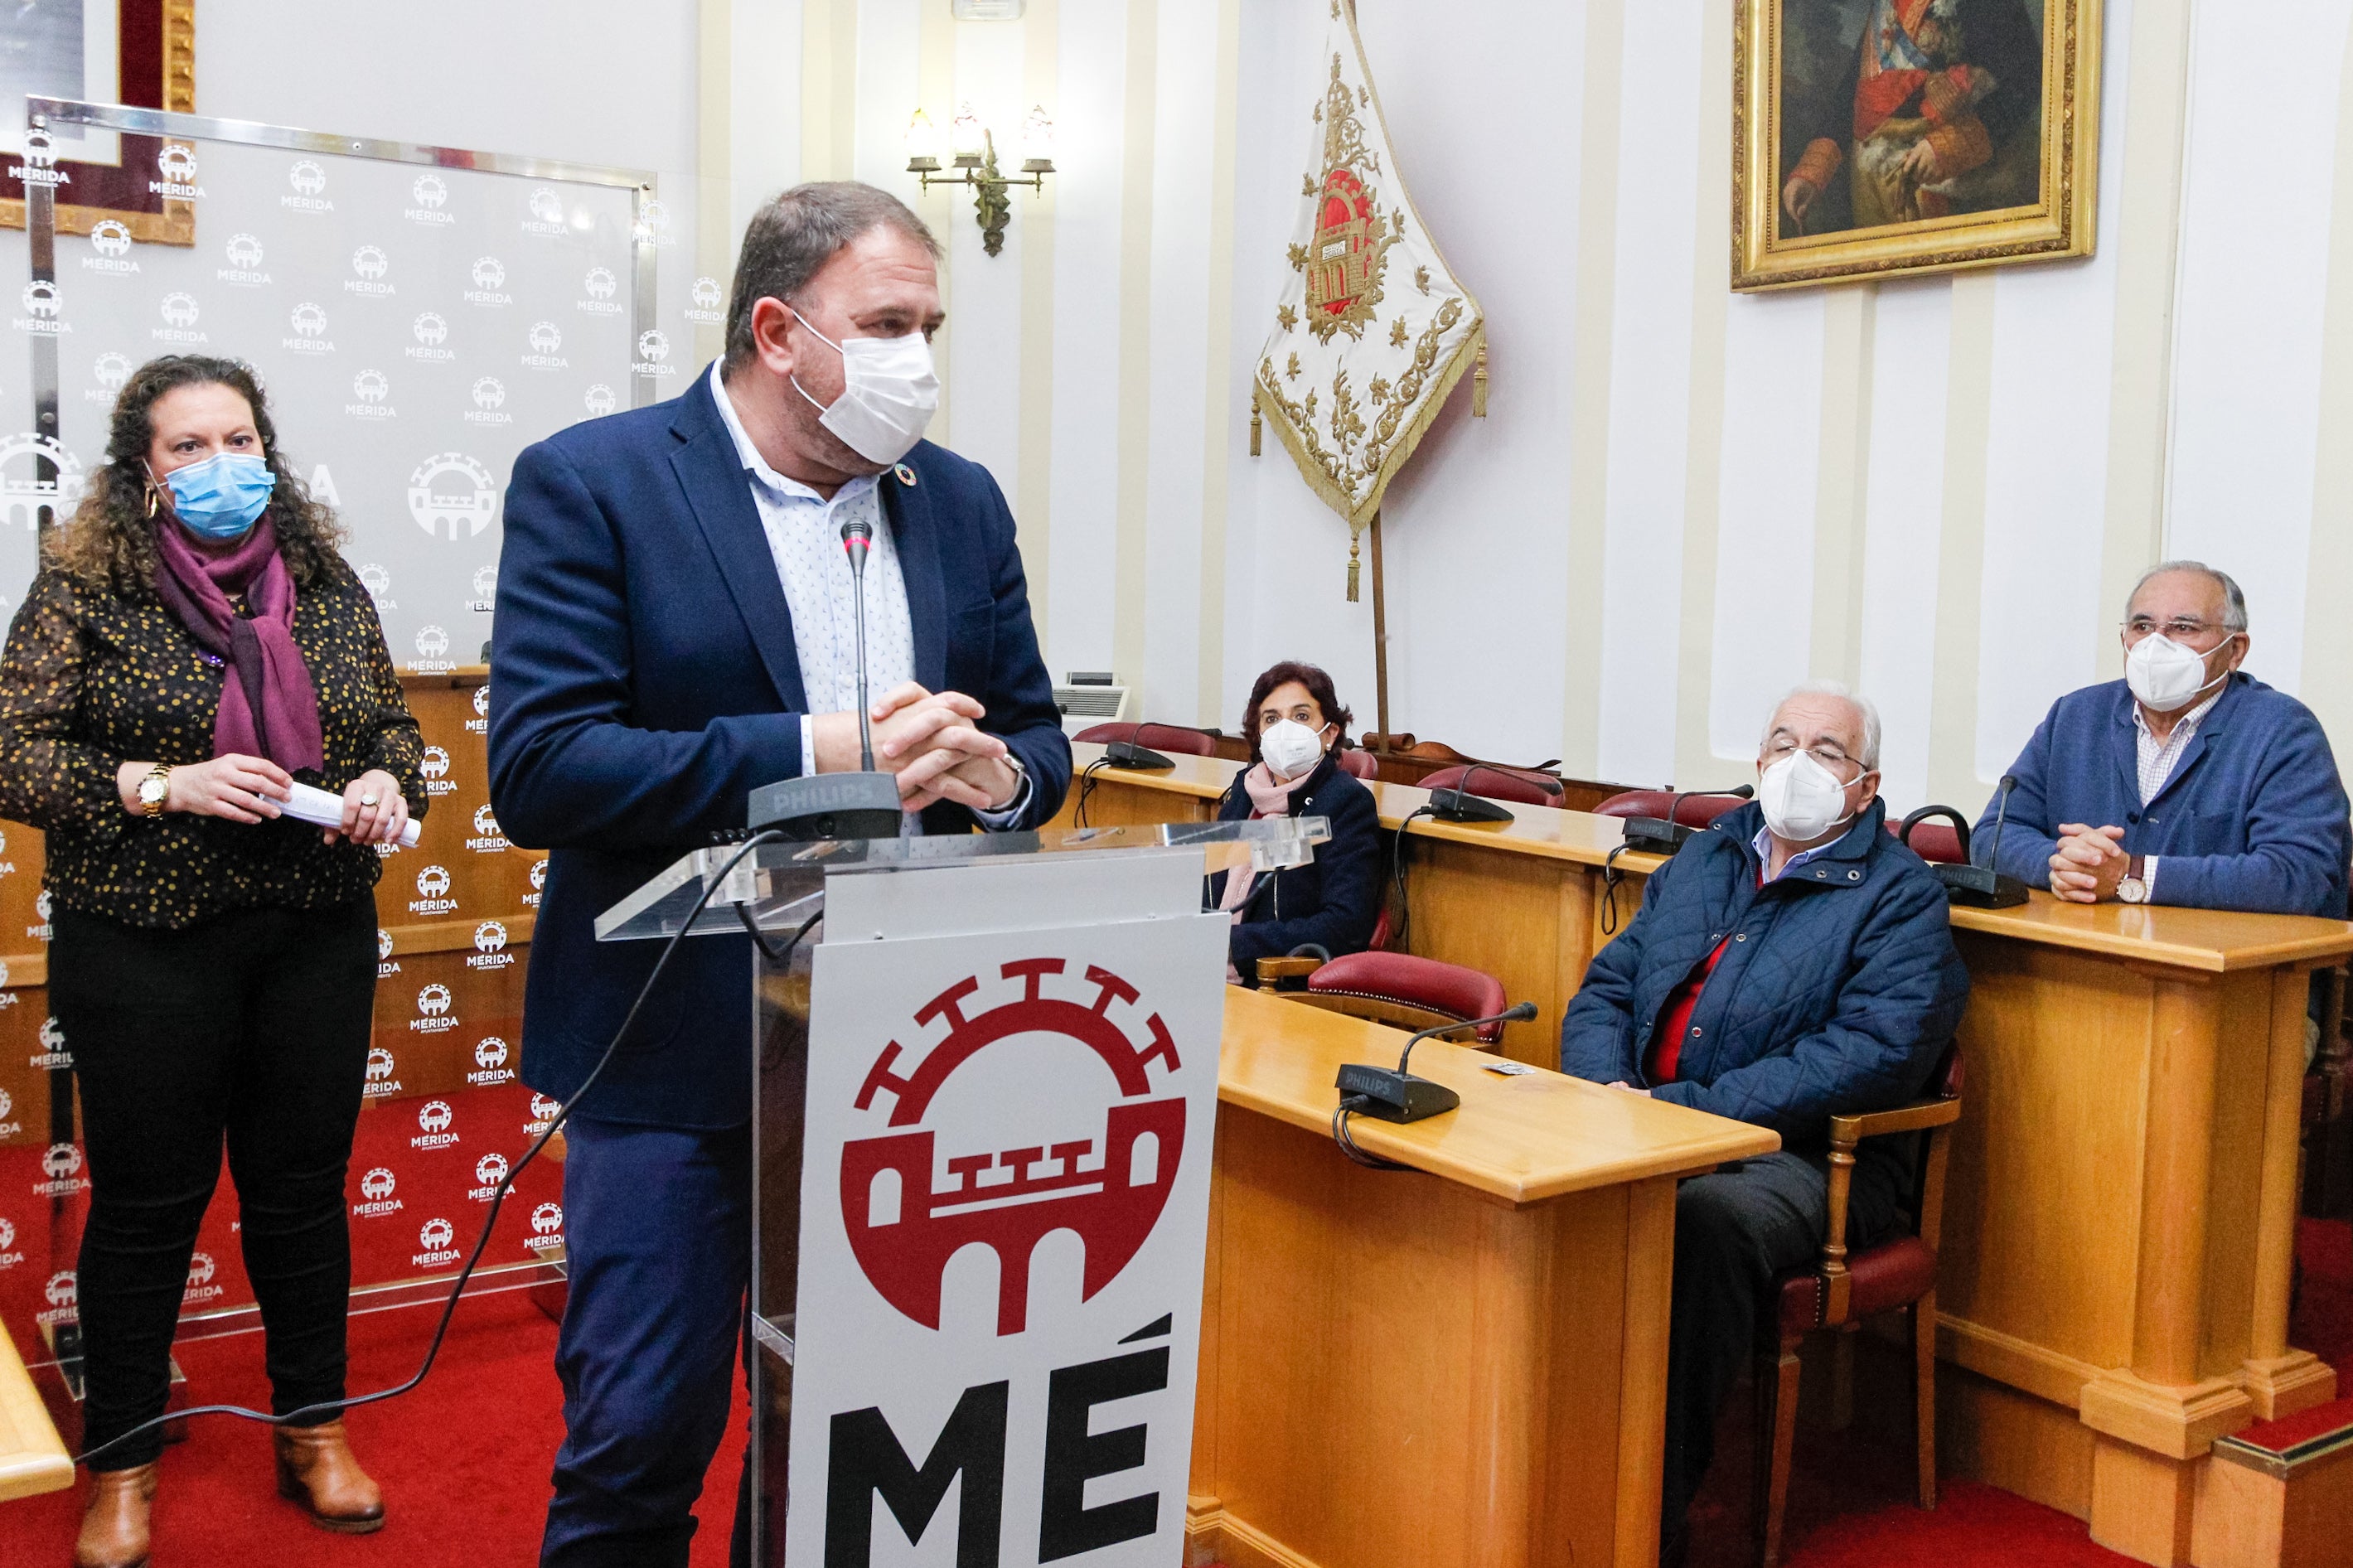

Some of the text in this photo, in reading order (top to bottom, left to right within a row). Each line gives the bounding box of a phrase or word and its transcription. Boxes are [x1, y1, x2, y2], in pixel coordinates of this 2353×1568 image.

[8, 166, 70, 183] MÉRIDA
[149, 180, 206, 198] MÉRIDA
[281, 195, 334, 212] MÉRIDA
[405, 208, 455, 225] MÉRIDA
[522, 220, 569, 236] MÉRIDA
[83, 256, 140, 273] MÉRIDA
[217, 268, 272, 285] MÉRIDA
[345, 279, 395, 295] MÉRIDA
[464, 289, 512, 305] MÉRIDA
[578, 299, 623, 314] MÉRIDA
[12, 317, 73, 333] MÉRIDA
[153, 327, 208, 344] MÉRIDA
[283, 336, 336, 352] MÉRIDA
[405, 345, 455, 360] MÉRIDA
[521, 353, 568, 368] MÉRIDA
[632, 361, 675, 375] MÉRIDA
[85, 389, 116, 401] MÉR
[346, 403, 396, 417] MÉRIDA
[465, 409, 512, 423] MÉRIDA
[375, 600, 398, 610] IDA
[465, 600, 494, 610] MÉRI
[407, 660, 456, 670] MÉRIDA
[427, 780, 458, 791] RIDA
[773, 785, 873, 812] PHILIPS
[1630, 822, 1663, 835] PHILIPS
[375, 843, 399, 854] IDA
[467, 836, 513, 849] MÉRIDA
[409, 898, 458, 912] MÉRIDA
[467, 953, 514, 966] MÉRIDA
[378, 961, 401, 974] IDA
[410, 1016, 458, 1030] MÉRIDA
[30, 1053, 74, 1067] MÉRI
[467, 1068, 515, 1082] MÉRIDA
[363, 1080, 402, 1094] ÉRIDA
[1346, 1072, 1391, 1095] PHILIPS
[411, 1134, 459, 1147] MÉRIDA
[33, 1178, 92, 1194] MÉRIDA
[468, 1185, 516, 1198] MÉRIA
[354, 1201, 403, 1215] MÉRIDA
[413, 1251, 461, 1265] MÉRIDA
[183, 1285, 223, 1299] ÉRIDA
[36, 1305, 79, 1323] MÉRI
[824, 1312, 1173, 1568] MÉ
